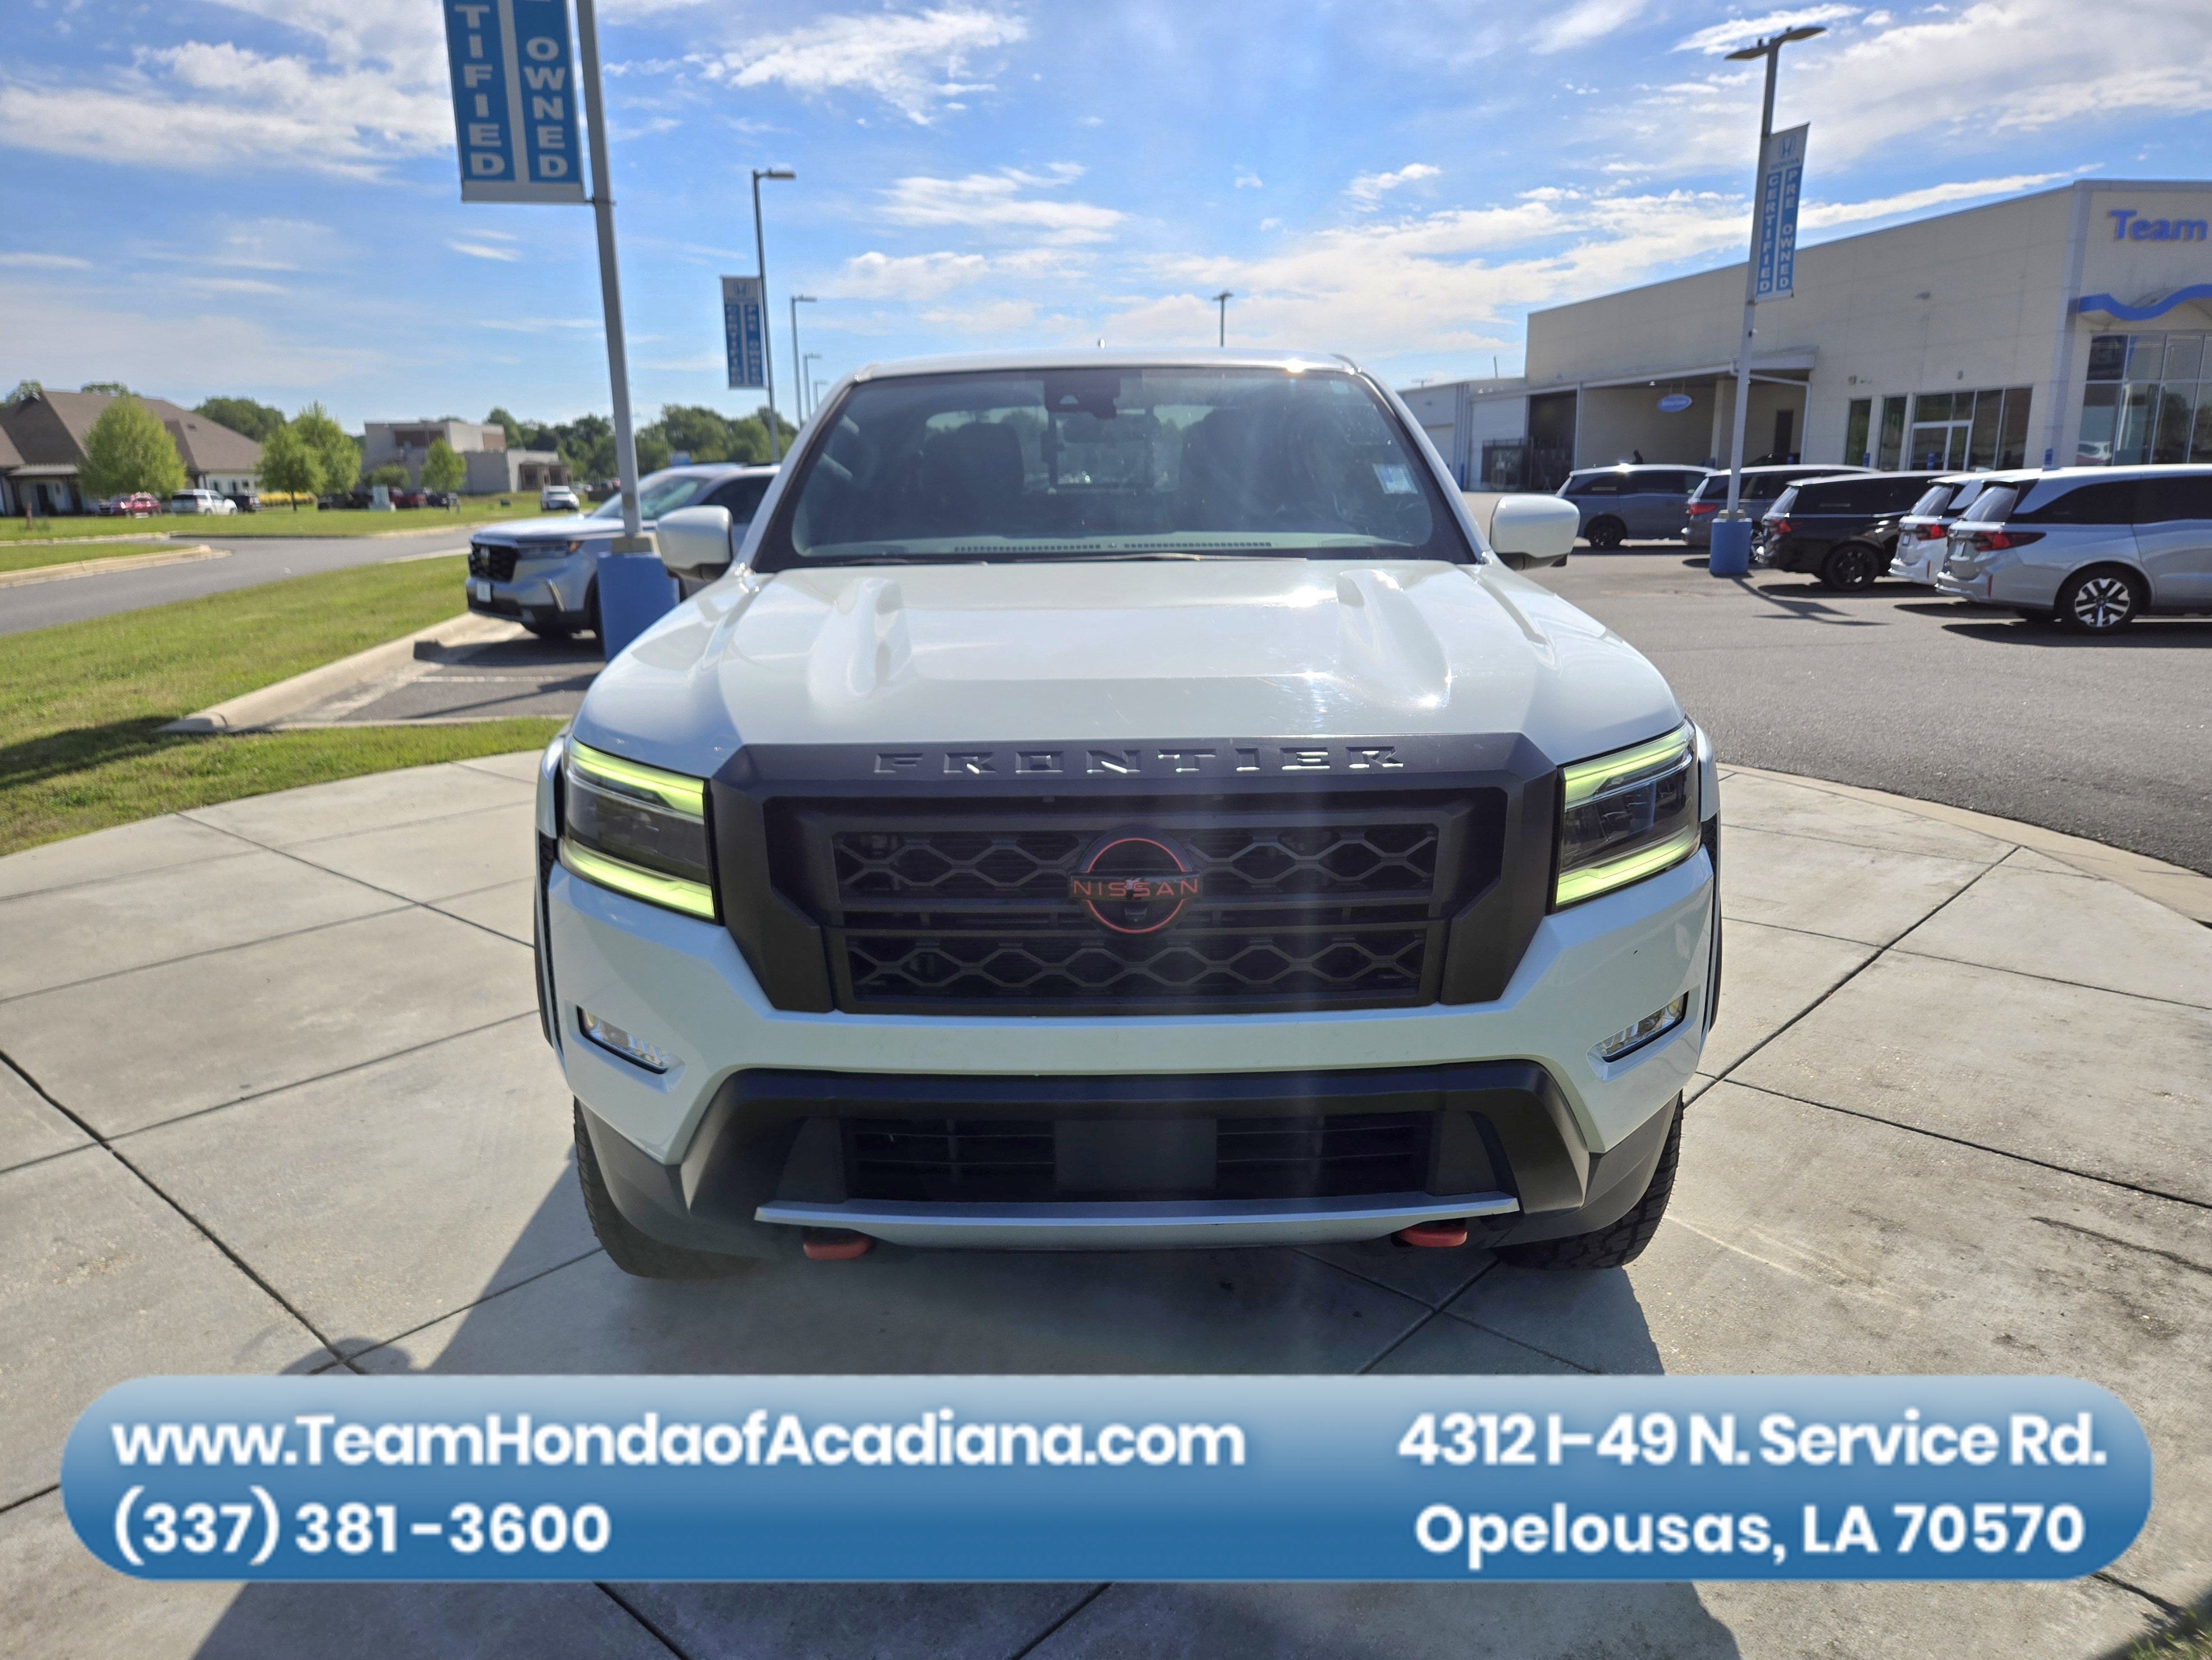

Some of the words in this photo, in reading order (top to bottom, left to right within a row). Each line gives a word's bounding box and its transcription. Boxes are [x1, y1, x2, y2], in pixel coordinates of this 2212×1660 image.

[523, 36, 568, 178] OWNED
[1785, 170, 1798, 208] PRE
[1759, 175, 1779, 291] CERTIFIED
[2109, 209, 2208, 240] Team
[1780, 224, 1794, 288] OWNED
[873, 746, 1404, 773] FRONTIER
[1073, 878, 1198, 897] NISSAN
